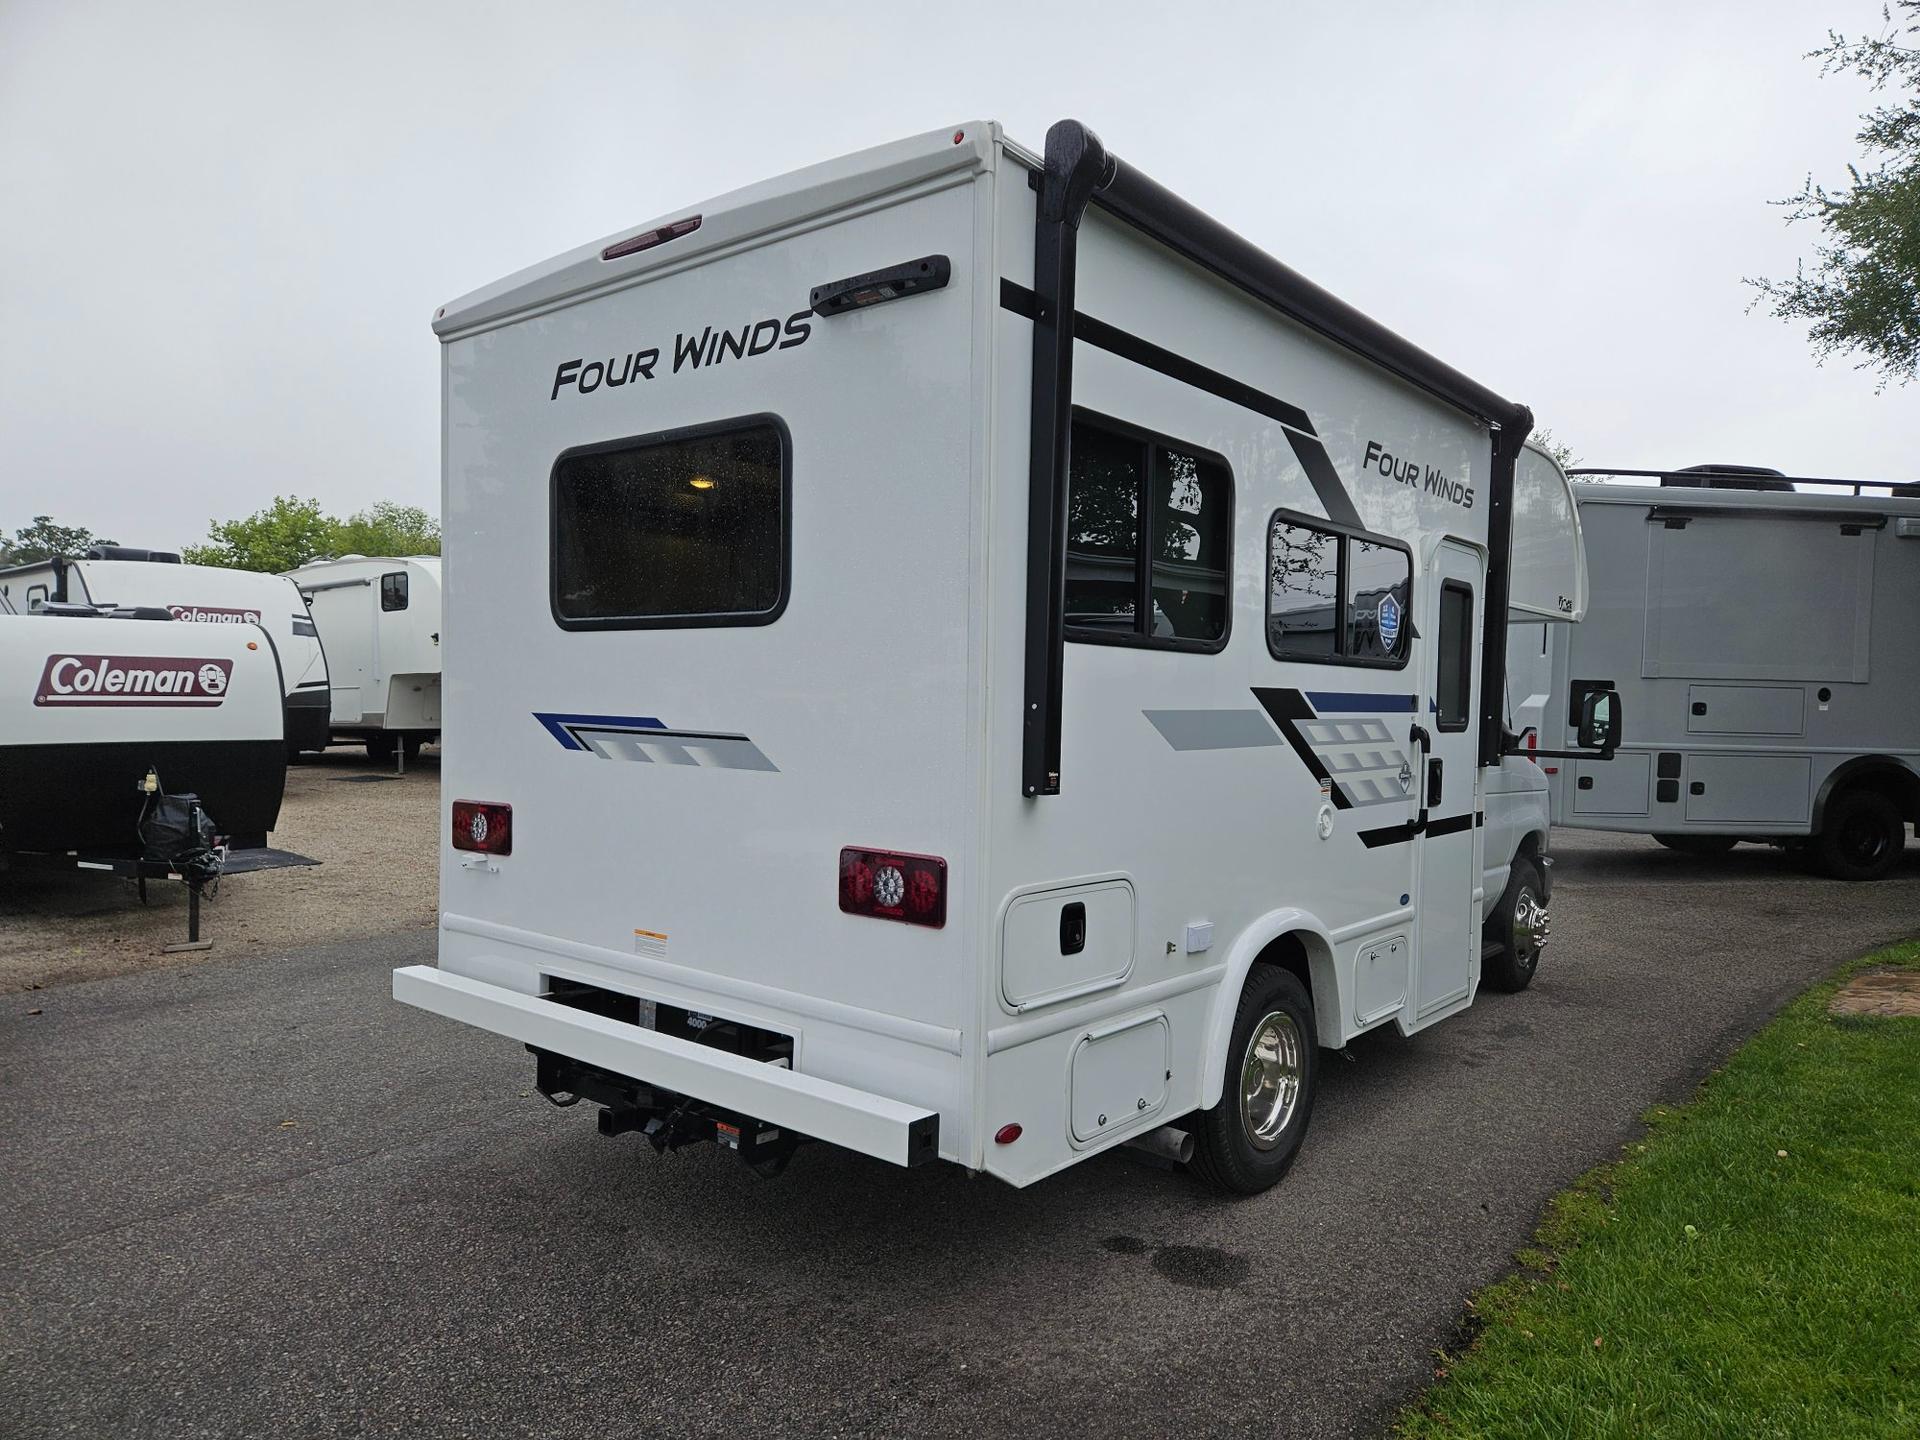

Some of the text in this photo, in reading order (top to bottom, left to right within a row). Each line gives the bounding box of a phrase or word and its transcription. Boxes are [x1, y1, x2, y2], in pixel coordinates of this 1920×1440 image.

[551, 309, 814, 401] FOUR WINDS
[1362, 440, 1475, 509] FOUR WINDS
[169, 606, 243, 624] Coleman
[51, 657, 195, 694] Coleman
[687, 1017, 707, 1029] 4000
